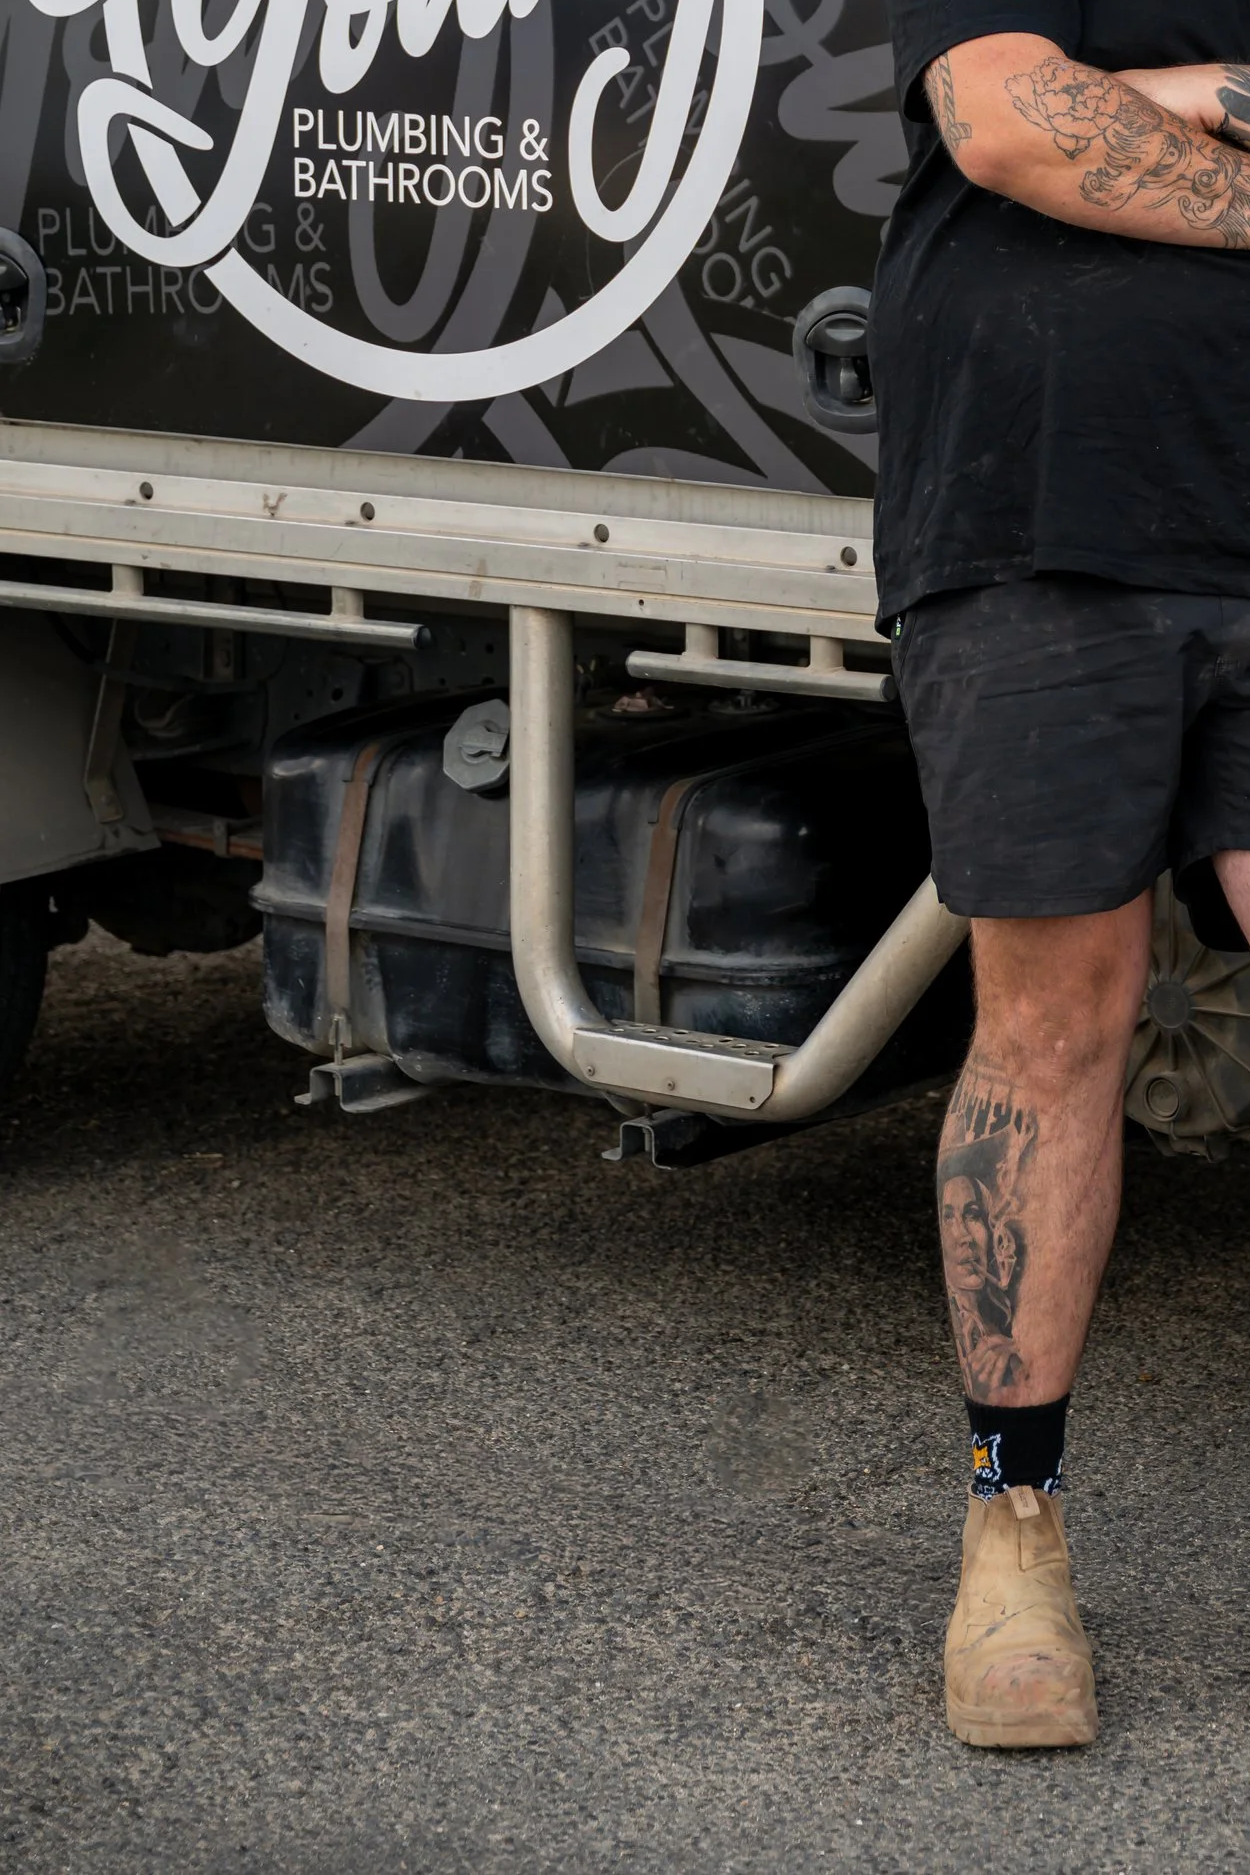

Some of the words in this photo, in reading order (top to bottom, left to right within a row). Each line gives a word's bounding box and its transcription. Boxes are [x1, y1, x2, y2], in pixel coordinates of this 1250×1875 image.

[293, 108, 504, 159] PLUMBING
[519, 118, 549, 161] &
[294, 157, 553, 212] BATHROOMS
[37, 202, 276, 257] PLUG
[295, 202, 326, 252] &
[46, 261, 334, 316] BATHROMS
